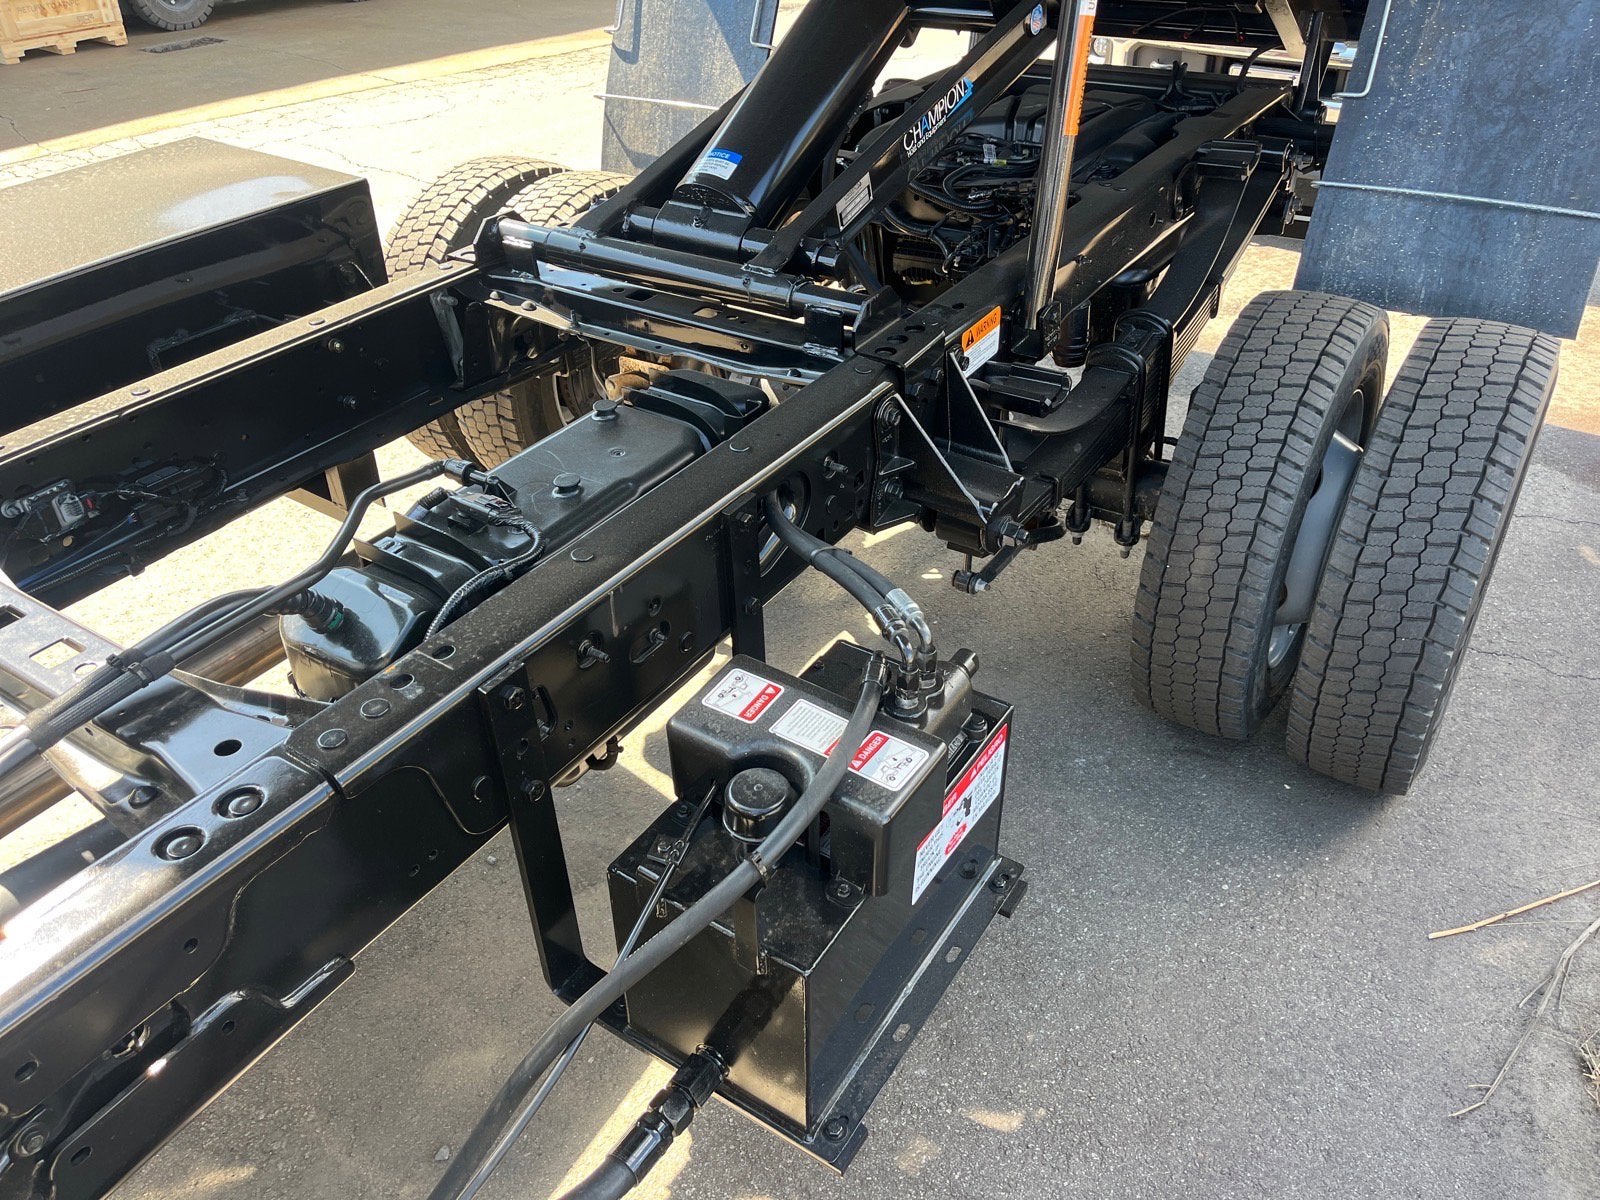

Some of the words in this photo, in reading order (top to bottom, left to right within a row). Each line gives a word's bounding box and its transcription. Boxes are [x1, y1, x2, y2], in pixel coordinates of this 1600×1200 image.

[903, 79, 965, 151] CHAMPION
[743, 694, 769, 718] DANGER
[858, 736, 884, 760] DANGER
[976, 733, 1004, 773] PELIGRO
